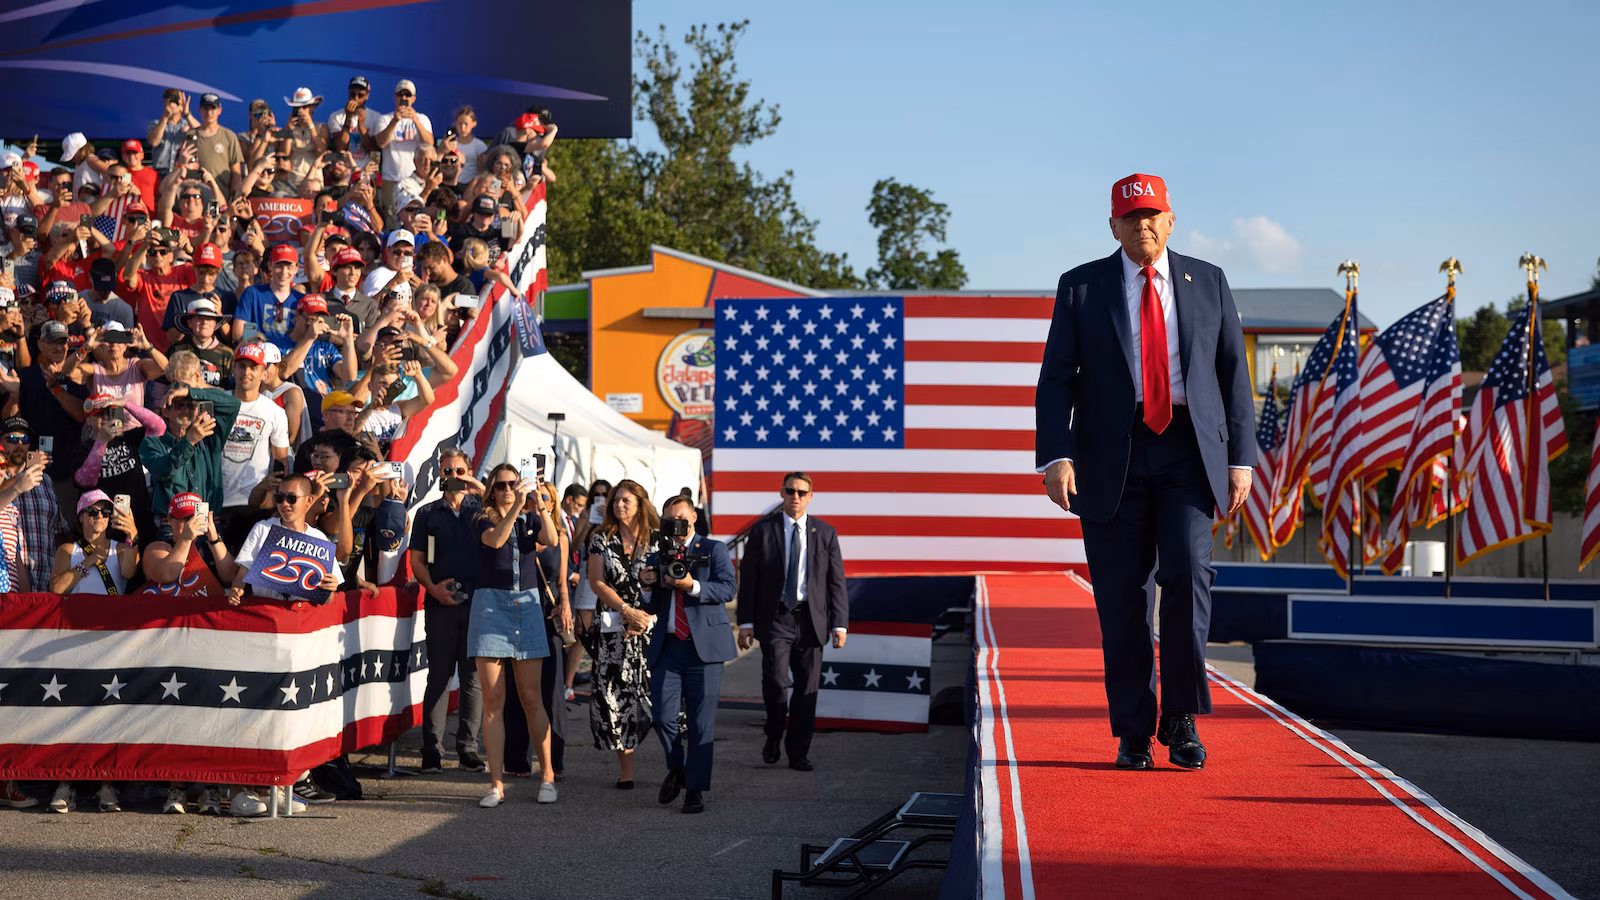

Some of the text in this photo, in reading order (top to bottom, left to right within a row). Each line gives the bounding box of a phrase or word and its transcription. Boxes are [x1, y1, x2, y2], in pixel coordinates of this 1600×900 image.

[1121, 182, 1156, 199] USA
[257, 202, 303, 212] AMERICA
[256, 213, 303, 235] 250
[102, 460, 136, 478] HEEP
[276, 535, 331, 562] AMERICA
[261, 551, 327, 591] 250
